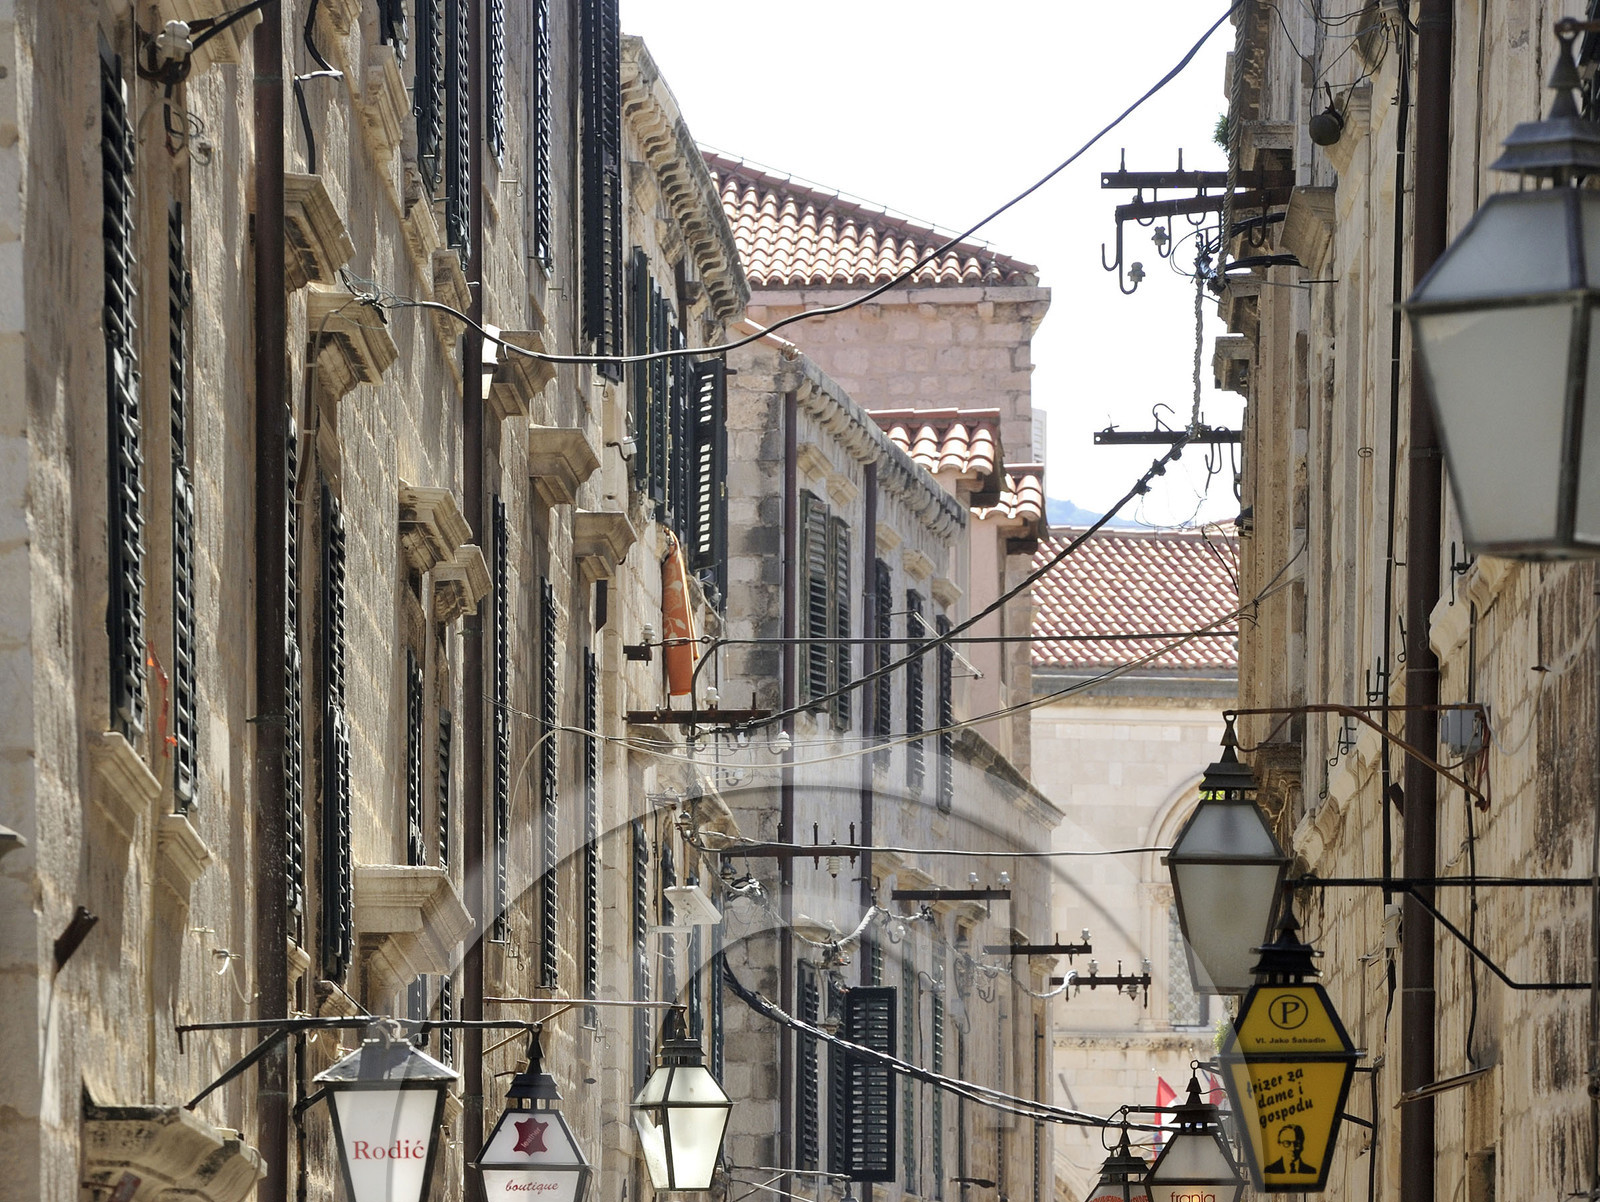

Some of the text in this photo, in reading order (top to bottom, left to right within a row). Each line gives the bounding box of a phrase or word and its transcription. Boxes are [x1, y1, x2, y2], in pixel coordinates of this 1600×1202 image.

[1281, 1001, 1300, 1024] P
[1269, 1036, 1290, 1044] Jako
[1287, 1068, 1304, 1082] za
[1258, 1081, 1304, 1109] dame i
[1259, 1097, 1314, 1129] gospodu
[352, 1139, 425, 1160] Rodić
[505, 1179, 559, 1195] boutique
